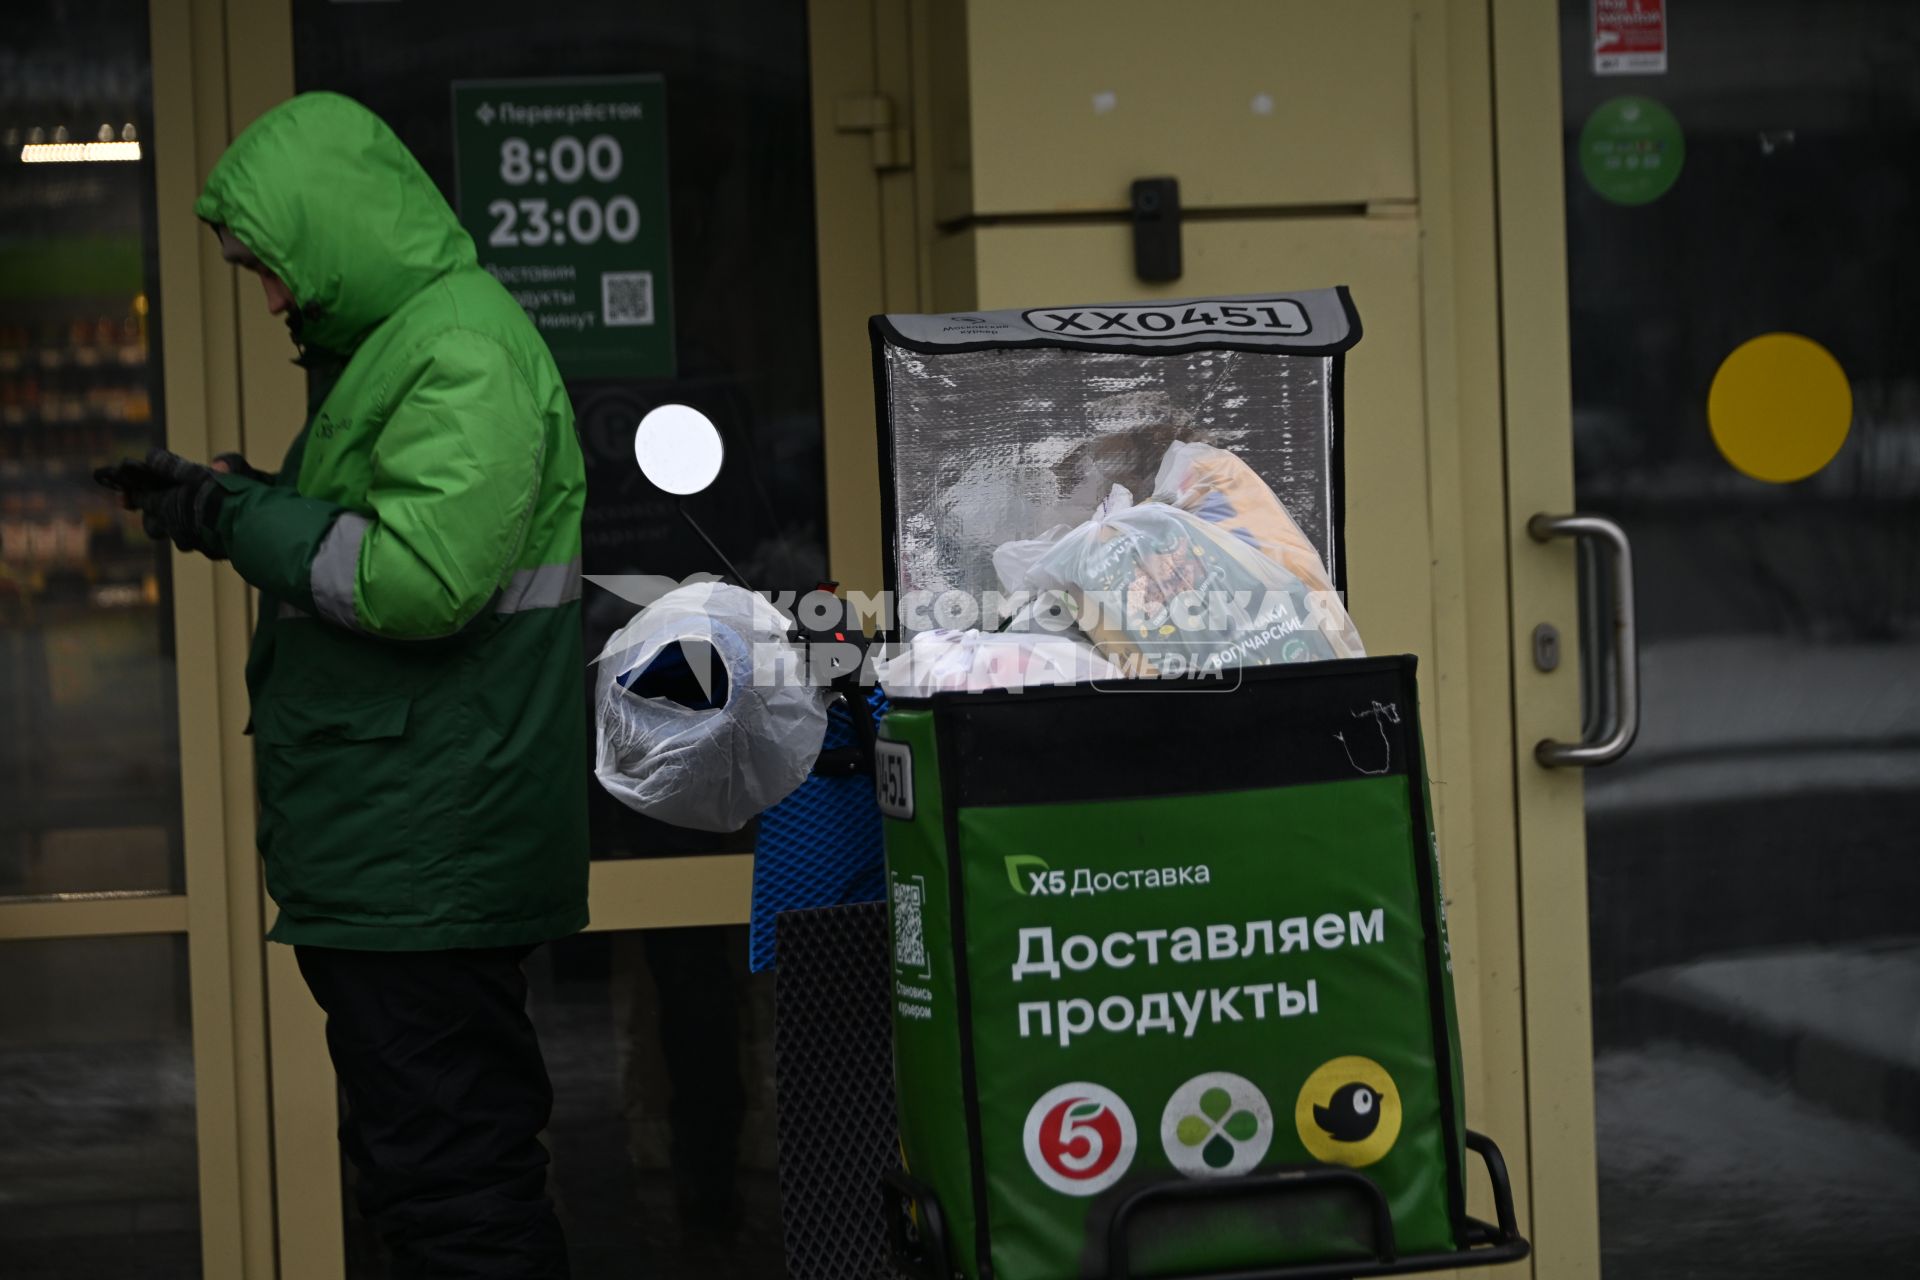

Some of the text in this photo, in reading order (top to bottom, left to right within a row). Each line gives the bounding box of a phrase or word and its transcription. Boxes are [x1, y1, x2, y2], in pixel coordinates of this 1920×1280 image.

[498, 101, 644, 126] Перекрёсток
[499, 133, 624, 185] 8:00
[487, 195, 641, 247] 23:00
[877, 750, 906, 807] 451
[1029, 863, 1210, 898] X5 Доставка
[1011, 907, 1385, 981] Доставляем
[896, 979, 933, 1003] Становись
[898, 1001, 933, 1023] курьером
[1017, 978, 1319, 1048] продукты
